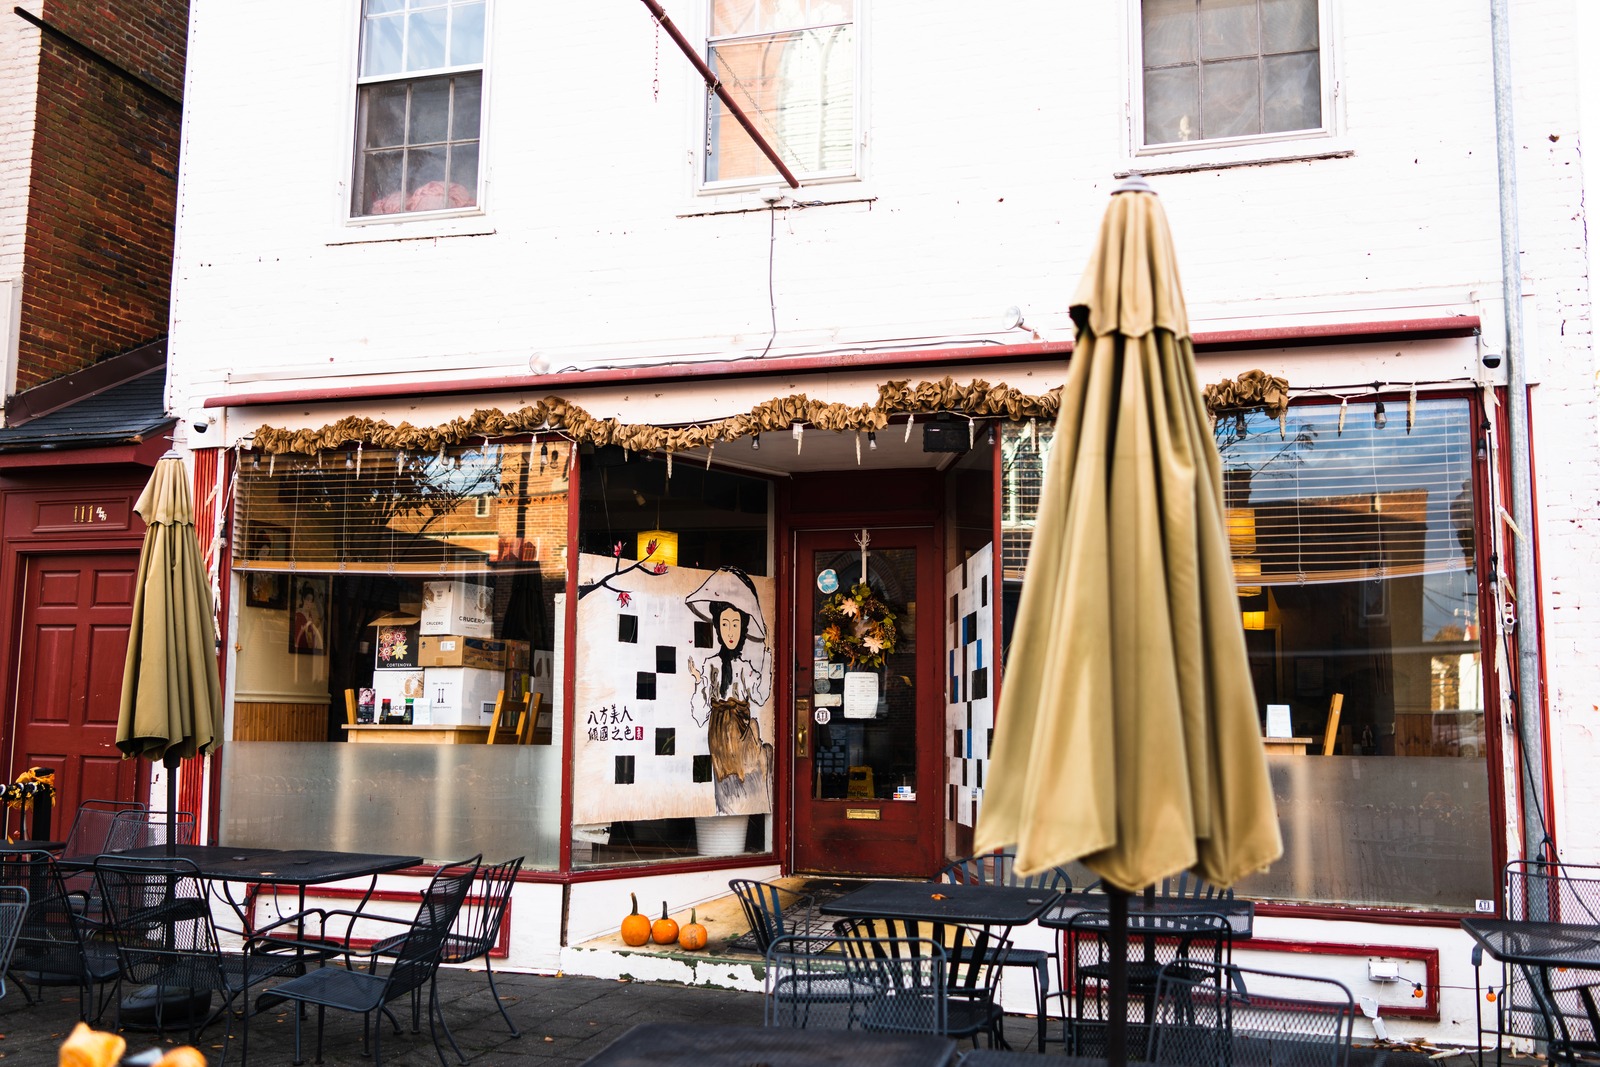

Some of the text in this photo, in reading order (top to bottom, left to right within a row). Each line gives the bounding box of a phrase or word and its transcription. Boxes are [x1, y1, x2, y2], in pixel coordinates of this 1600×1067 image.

[74, 505, 93, 522] 111
[458, 615, 486, 625] CRUCERO
[587, 703, 633, 725] 八方美人
